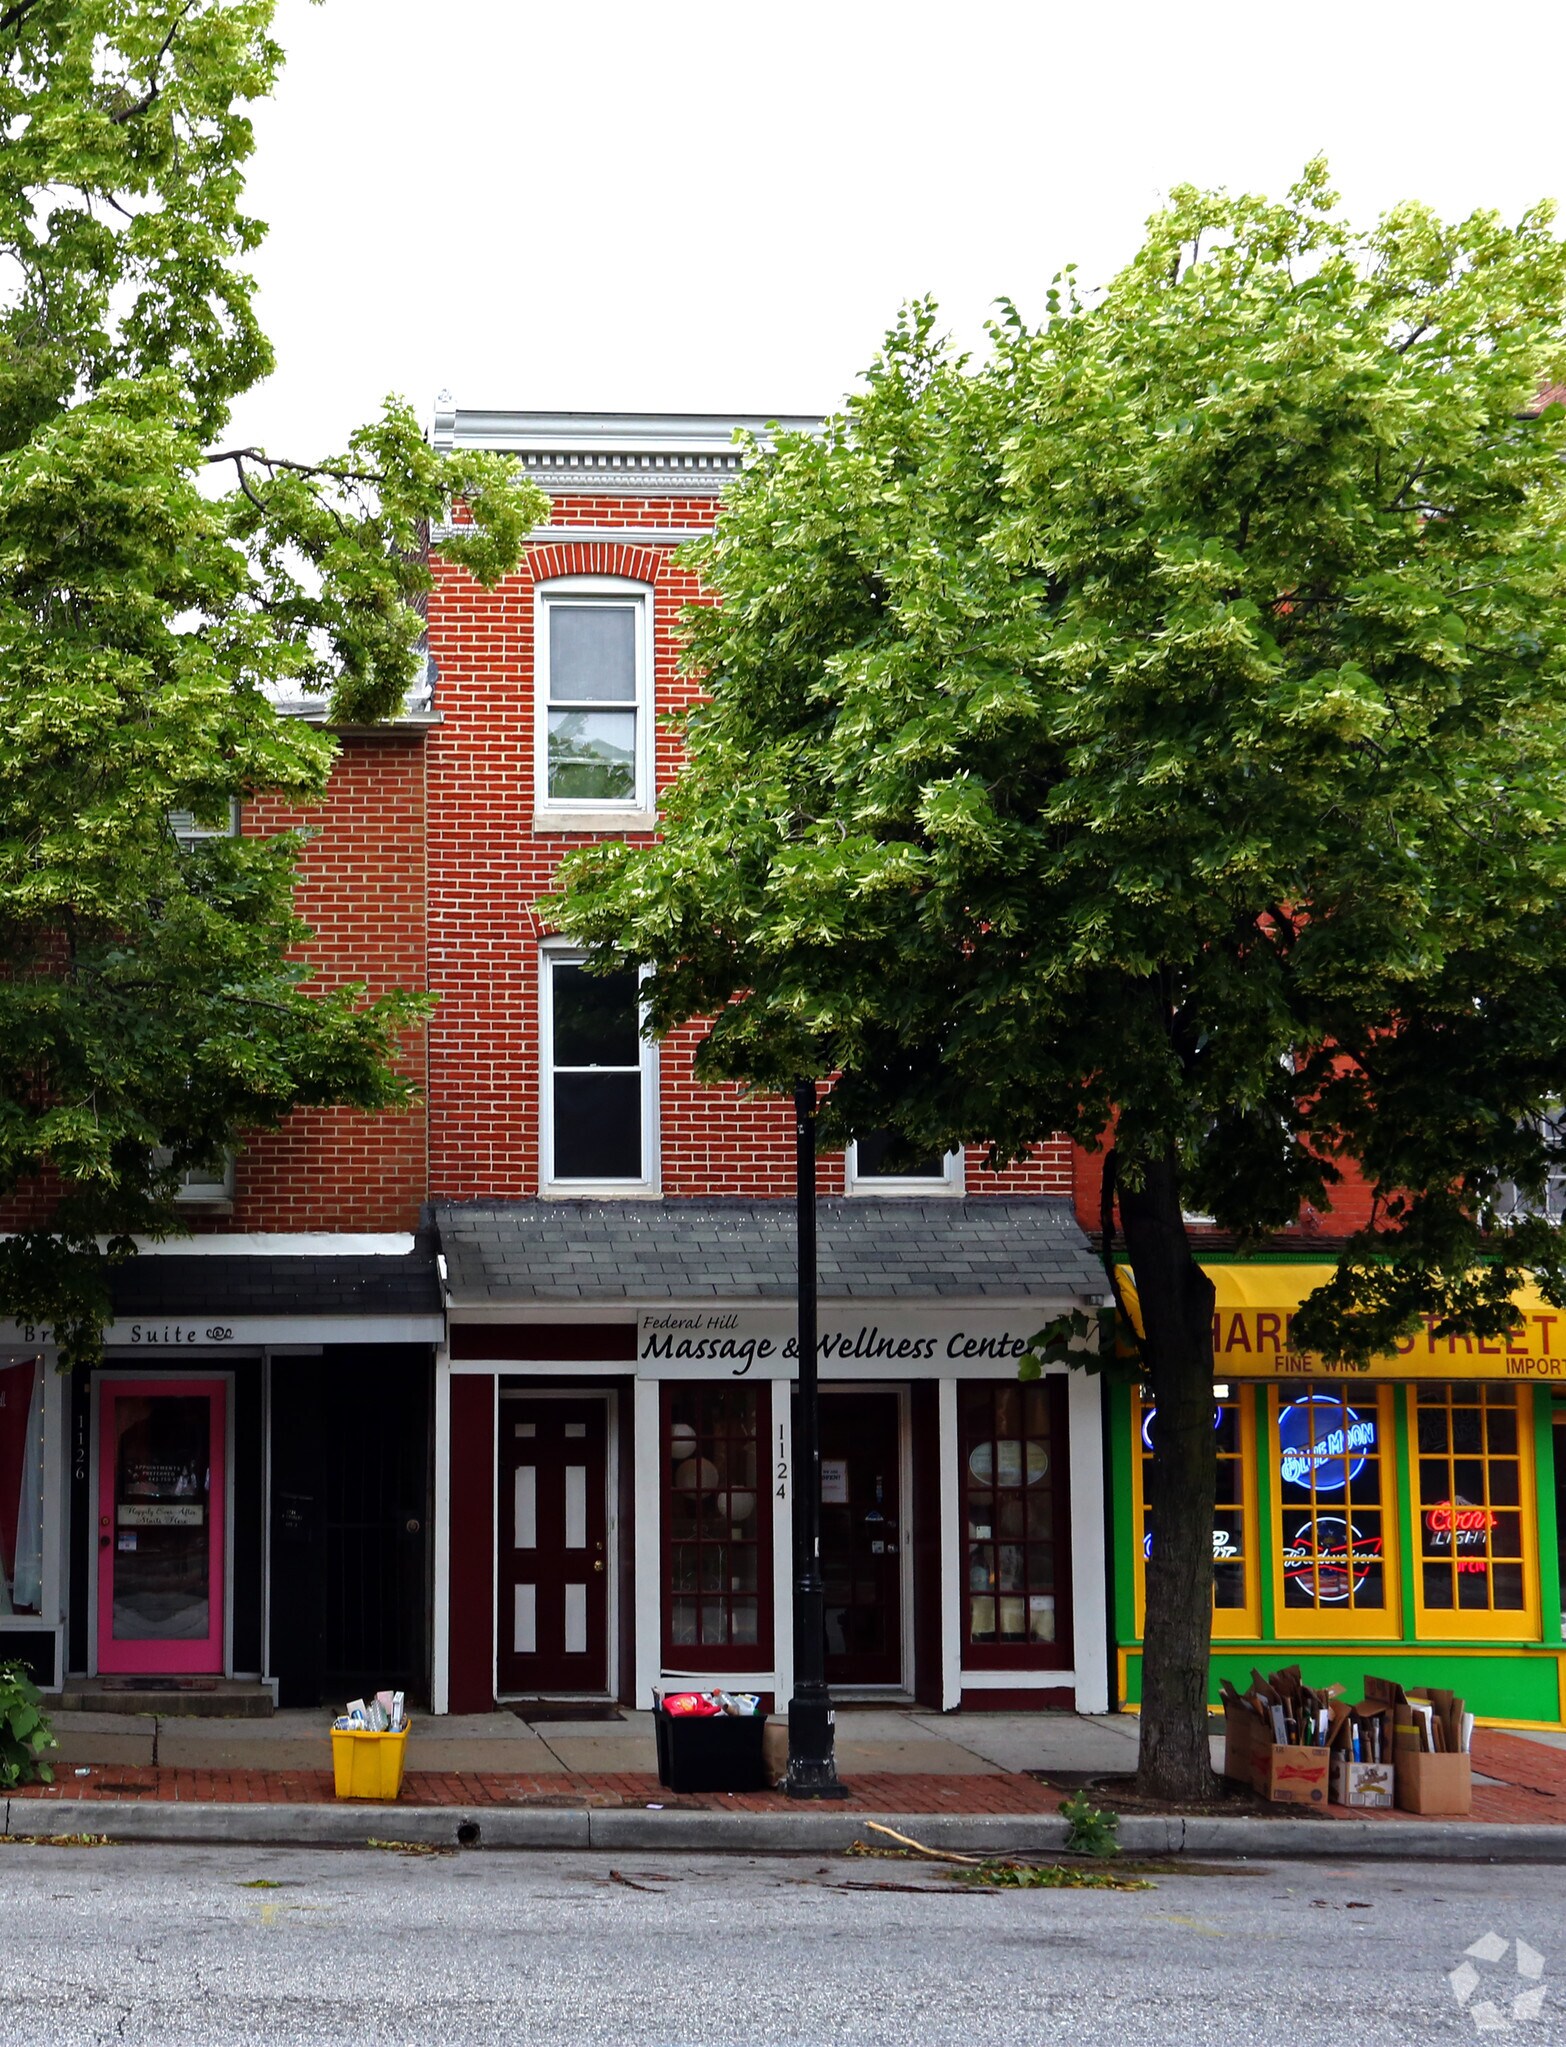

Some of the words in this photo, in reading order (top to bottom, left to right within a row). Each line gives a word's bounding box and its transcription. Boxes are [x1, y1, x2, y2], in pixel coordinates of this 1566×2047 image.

[131, 1325, 196, 1342] Suite
[643, 1314, 702, 1329] Federal
[706, 1314, 739, 1329] Hill
[641, 1333, 777, 1375] Massage
[781, 1337, 800, 1358] &
[817, 1327, 937, 1359] Wellness
[1275, 1356, 1312, 1372] FINE
[1325, 1358, 1361, 1372] WIN
[75, 1415, 85, 1479] 1126
[776, 1424, 787, 1499] 1124
[1428, 1502, 1497, 1531] Coors
